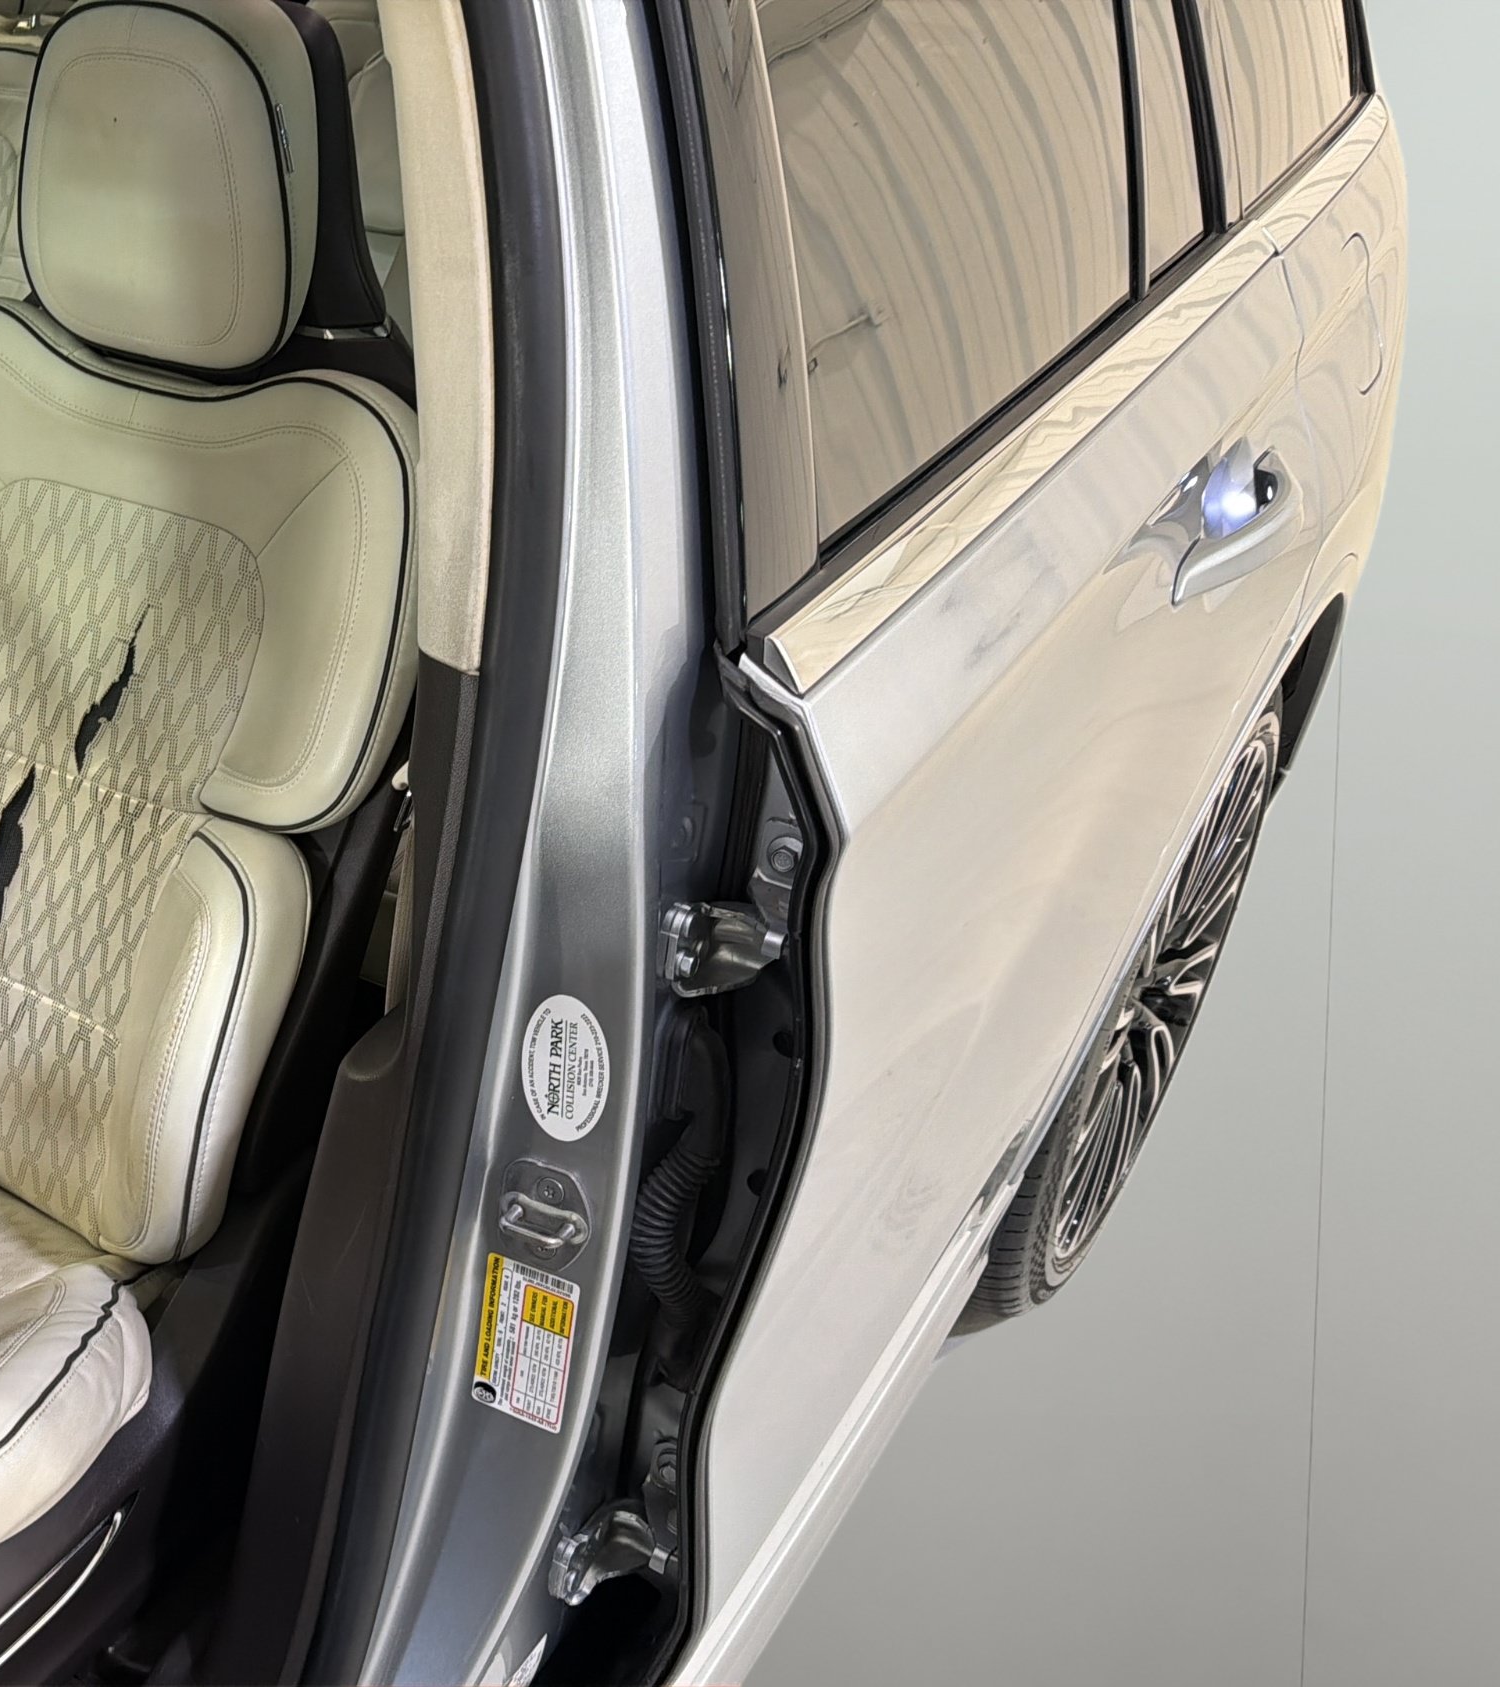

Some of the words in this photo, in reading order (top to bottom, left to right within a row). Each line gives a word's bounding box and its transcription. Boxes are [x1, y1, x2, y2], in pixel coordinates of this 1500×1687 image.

[549, 1018, 563, 1058] PARK
[568, 1022, 578, 1062] CENTER
[529, 1079, 535, 1088] AN
[530, 1088, 537, 1097] OF
[545, 1062, 562, 1116] NORTH
[565, 1063, 576, 1120] COLLISION
[575, 1100, 600, 1132] PROFESSIONAL
[596, 1047, 605, 1071] SERVICE
[533, 1098, 542, 1113] CASE
[488, 1256, 500, 1308] INFORMATION
[485, 1309, 494, 1342] LOADING
[480, 1360, 488, 1376] TIRE
[482, 1343, 490, 1358] AND
